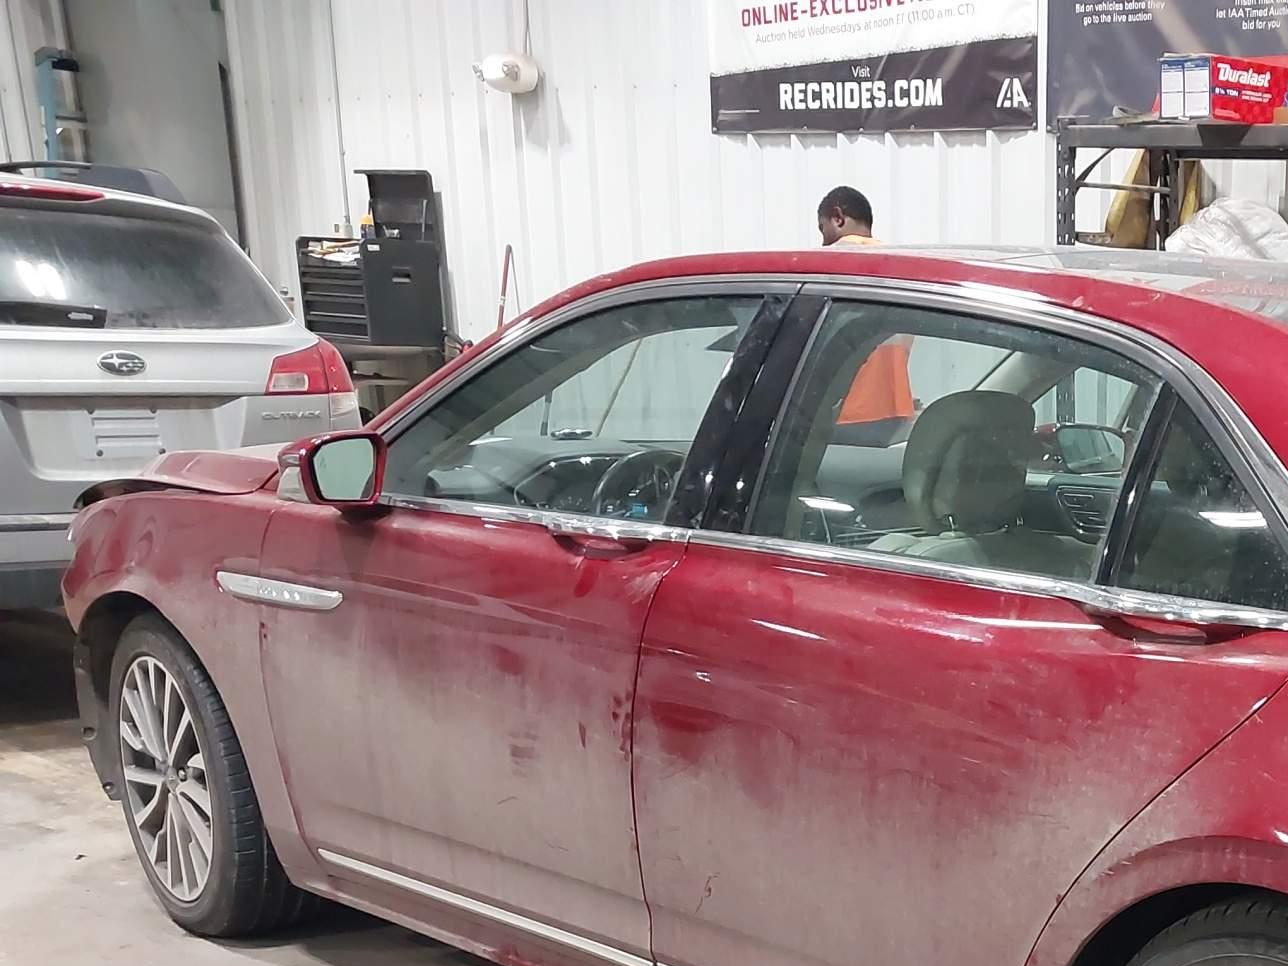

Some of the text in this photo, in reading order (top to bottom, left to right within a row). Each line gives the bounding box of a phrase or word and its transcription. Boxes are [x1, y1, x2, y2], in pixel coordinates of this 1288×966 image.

[741, 0, 905, 27] ONLINE-EXCLUSI
[1086, 4, 1094, 12] on
[1094, 1, 1123, 12] vehicles
[1124, 0, 1146, 10] before
[1083, 16, 1092, 26] go
[1092, 15, 1100, 24] to
[1100, 13, 1112, 23] the
[1127, 11, 1153, 22] auction
[1242, 19, 1281, 31] bid for you
[755, 32, 787, 44] Auction
[807, 20, 861, 37] Wednesdays
[864, 20, 872, 31] at
[873, 16, 895, 28] noon
[851, 65, 872, 78] Visit
[1216, 62, 1271, 88] Duralast
[779, 78, 943, 110] RECRIDES.COM
